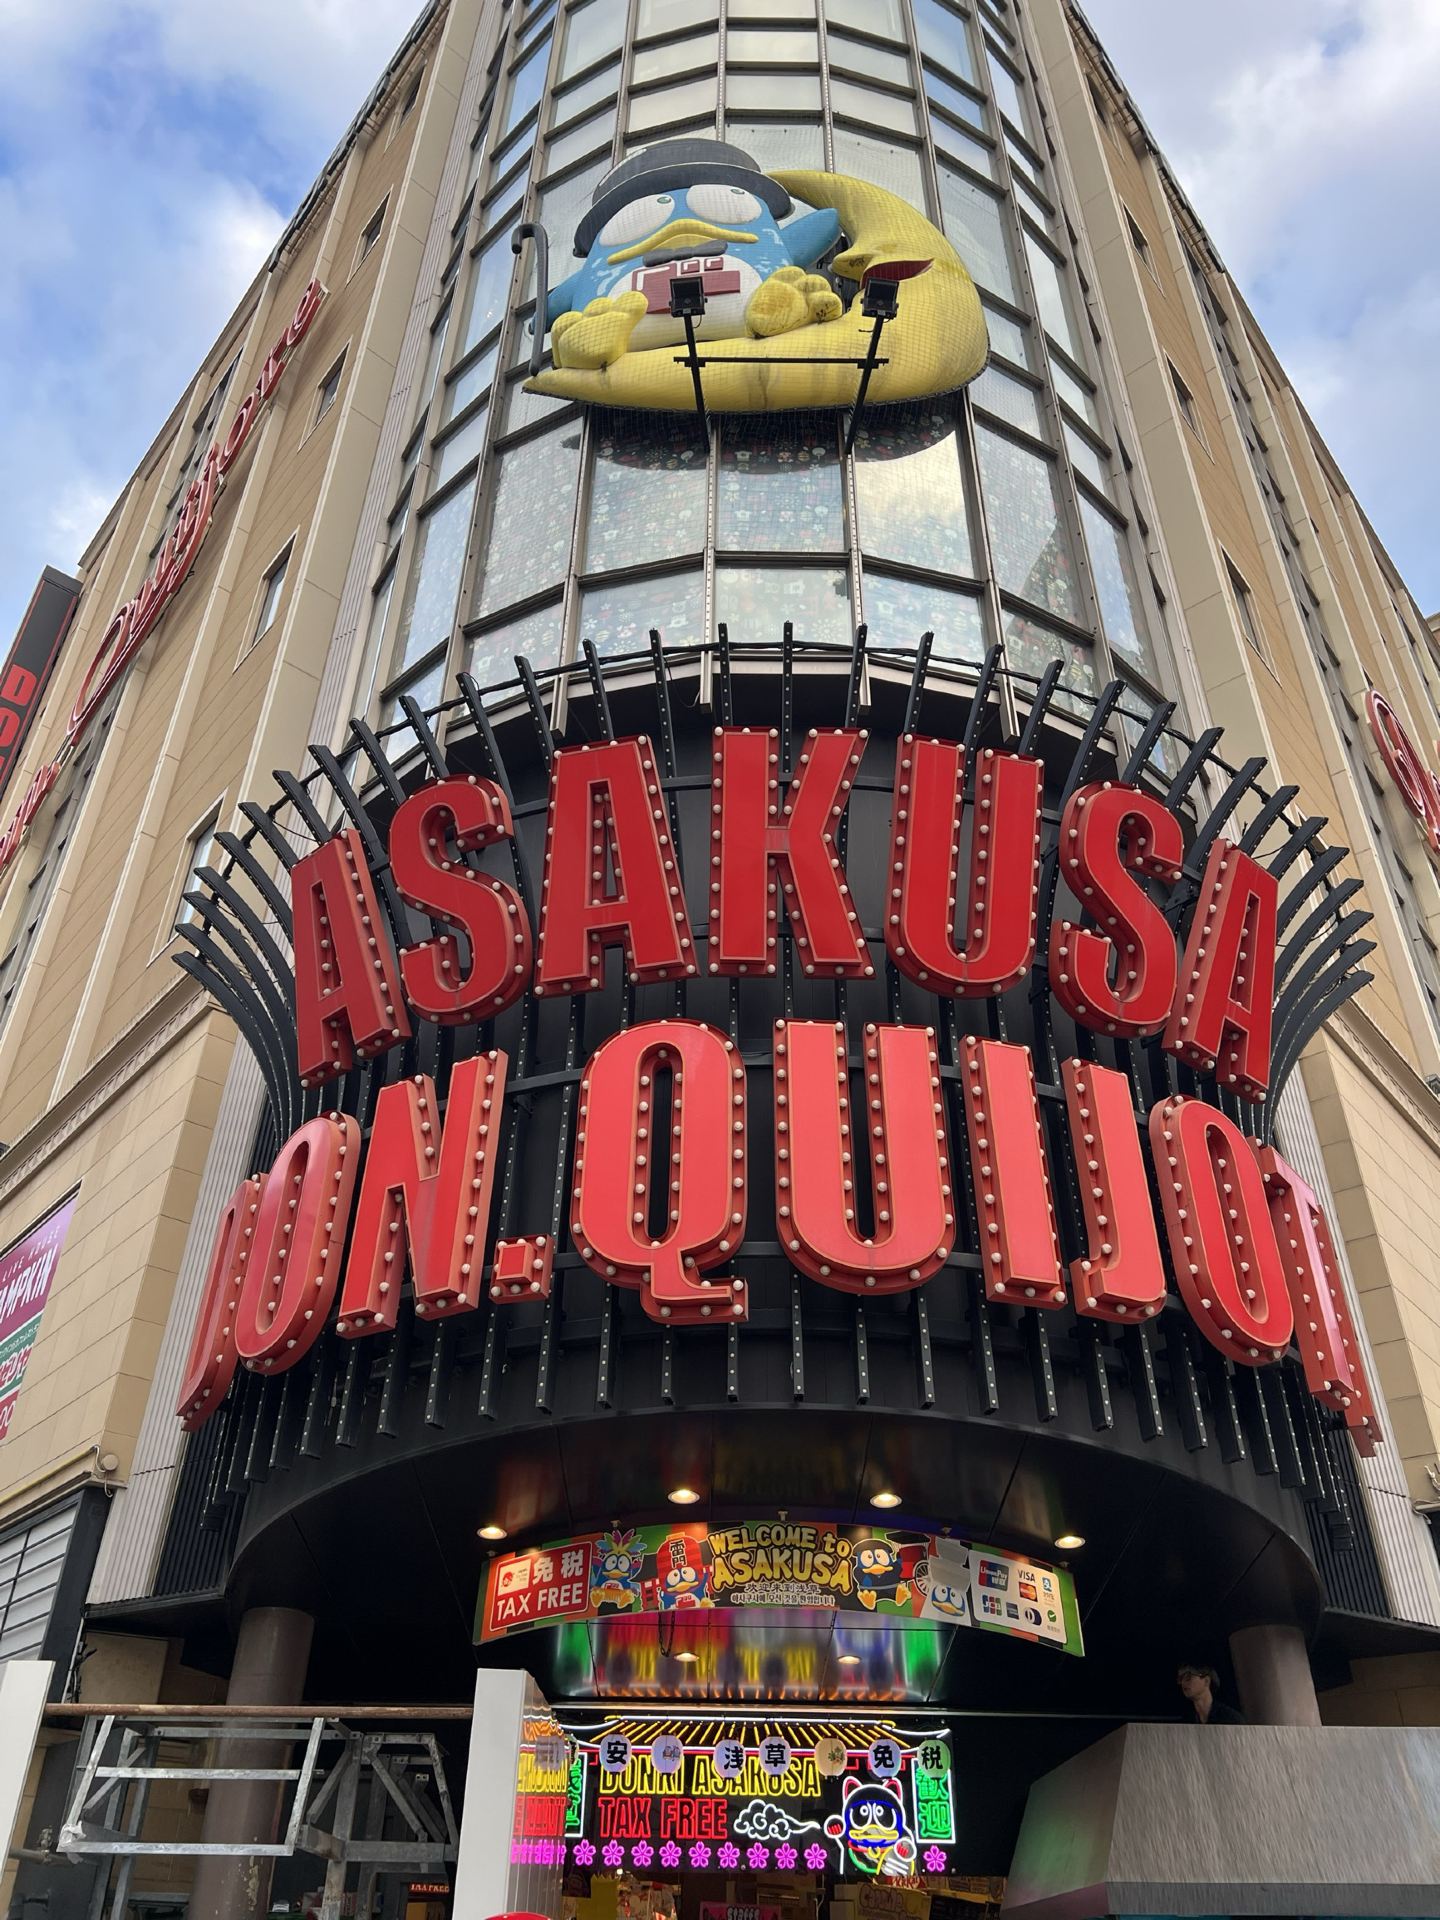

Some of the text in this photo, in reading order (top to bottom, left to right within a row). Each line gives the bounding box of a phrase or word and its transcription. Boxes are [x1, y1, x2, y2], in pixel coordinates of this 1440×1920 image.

[290, 726, 1279, 1102] ASAKUSA
[2, 1256, 25, 1283] LIVE
[709, 1525, 851, 1557] WELCOME to
[532, 1549, 584, 1585] 免税
[712, 1548, 852, 1593] ASAKUSA
[1018, 1569, 1036, 1583] VISA
[497, 1582, 583, 1621] TAX FREE
[598, 1797, 652, 1838] TAX
[659, 1798, 729, 1839] FREE
